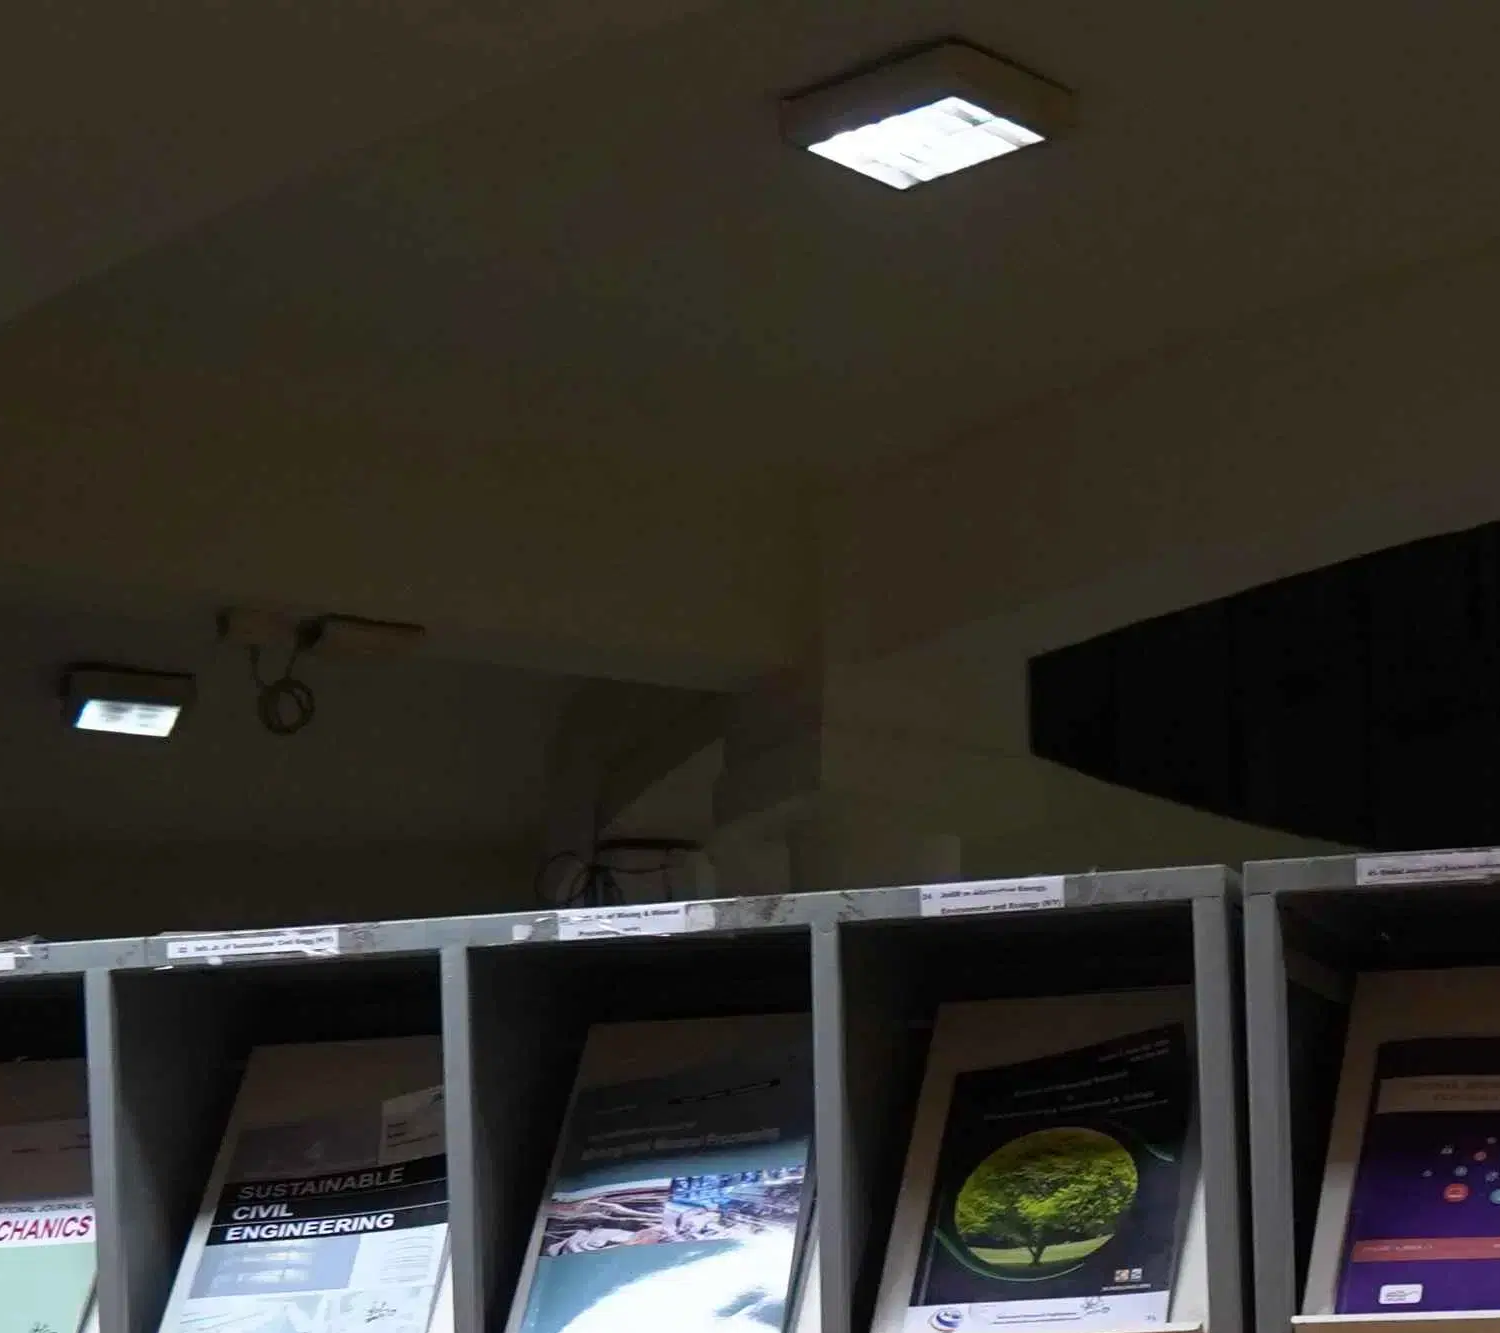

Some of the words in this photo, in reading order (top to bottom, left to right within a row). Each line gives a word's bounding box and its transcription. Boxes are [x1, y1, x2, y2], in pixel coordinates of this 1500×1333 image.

[236, 1167, 406, 1200] SUSTAINABLE
[231, 1202, 294, 1221] CIVIL
[224, 1212, 395, 1242] ENGINEERING
